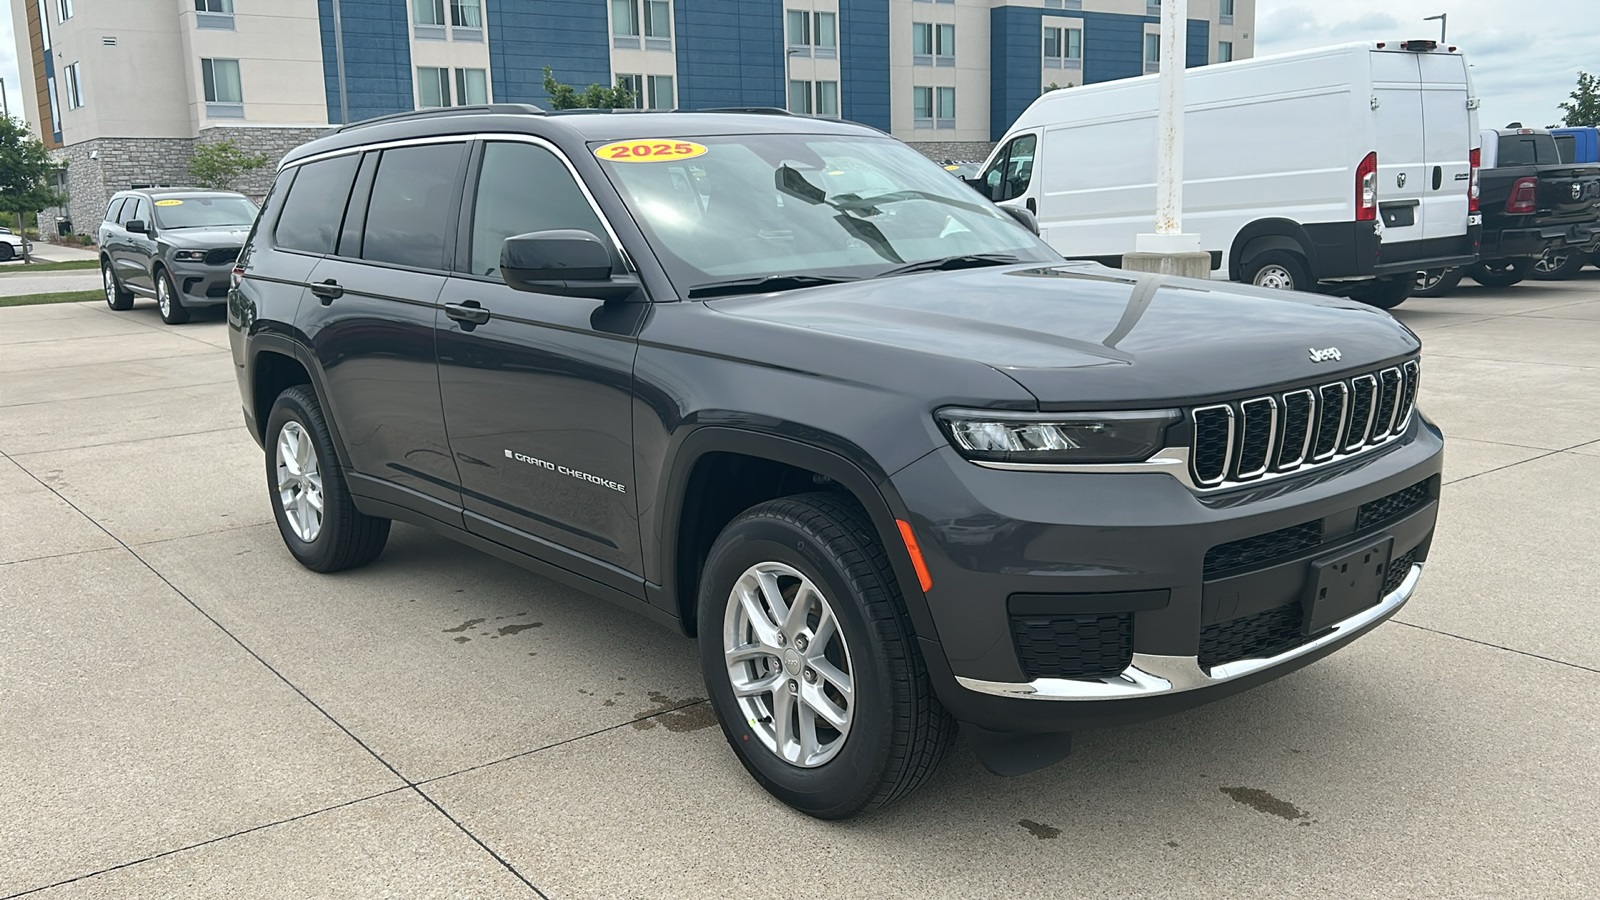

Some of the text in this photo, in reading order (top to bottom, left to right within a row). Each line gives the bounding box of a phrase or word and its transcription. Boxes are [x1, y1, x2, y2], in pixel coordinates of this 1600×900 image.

[610, 143, 693, 158] 2025
[1308, 347, 1342, 363] Jeep
[514, 452, 627, 494] GRAND CHEROKEE
